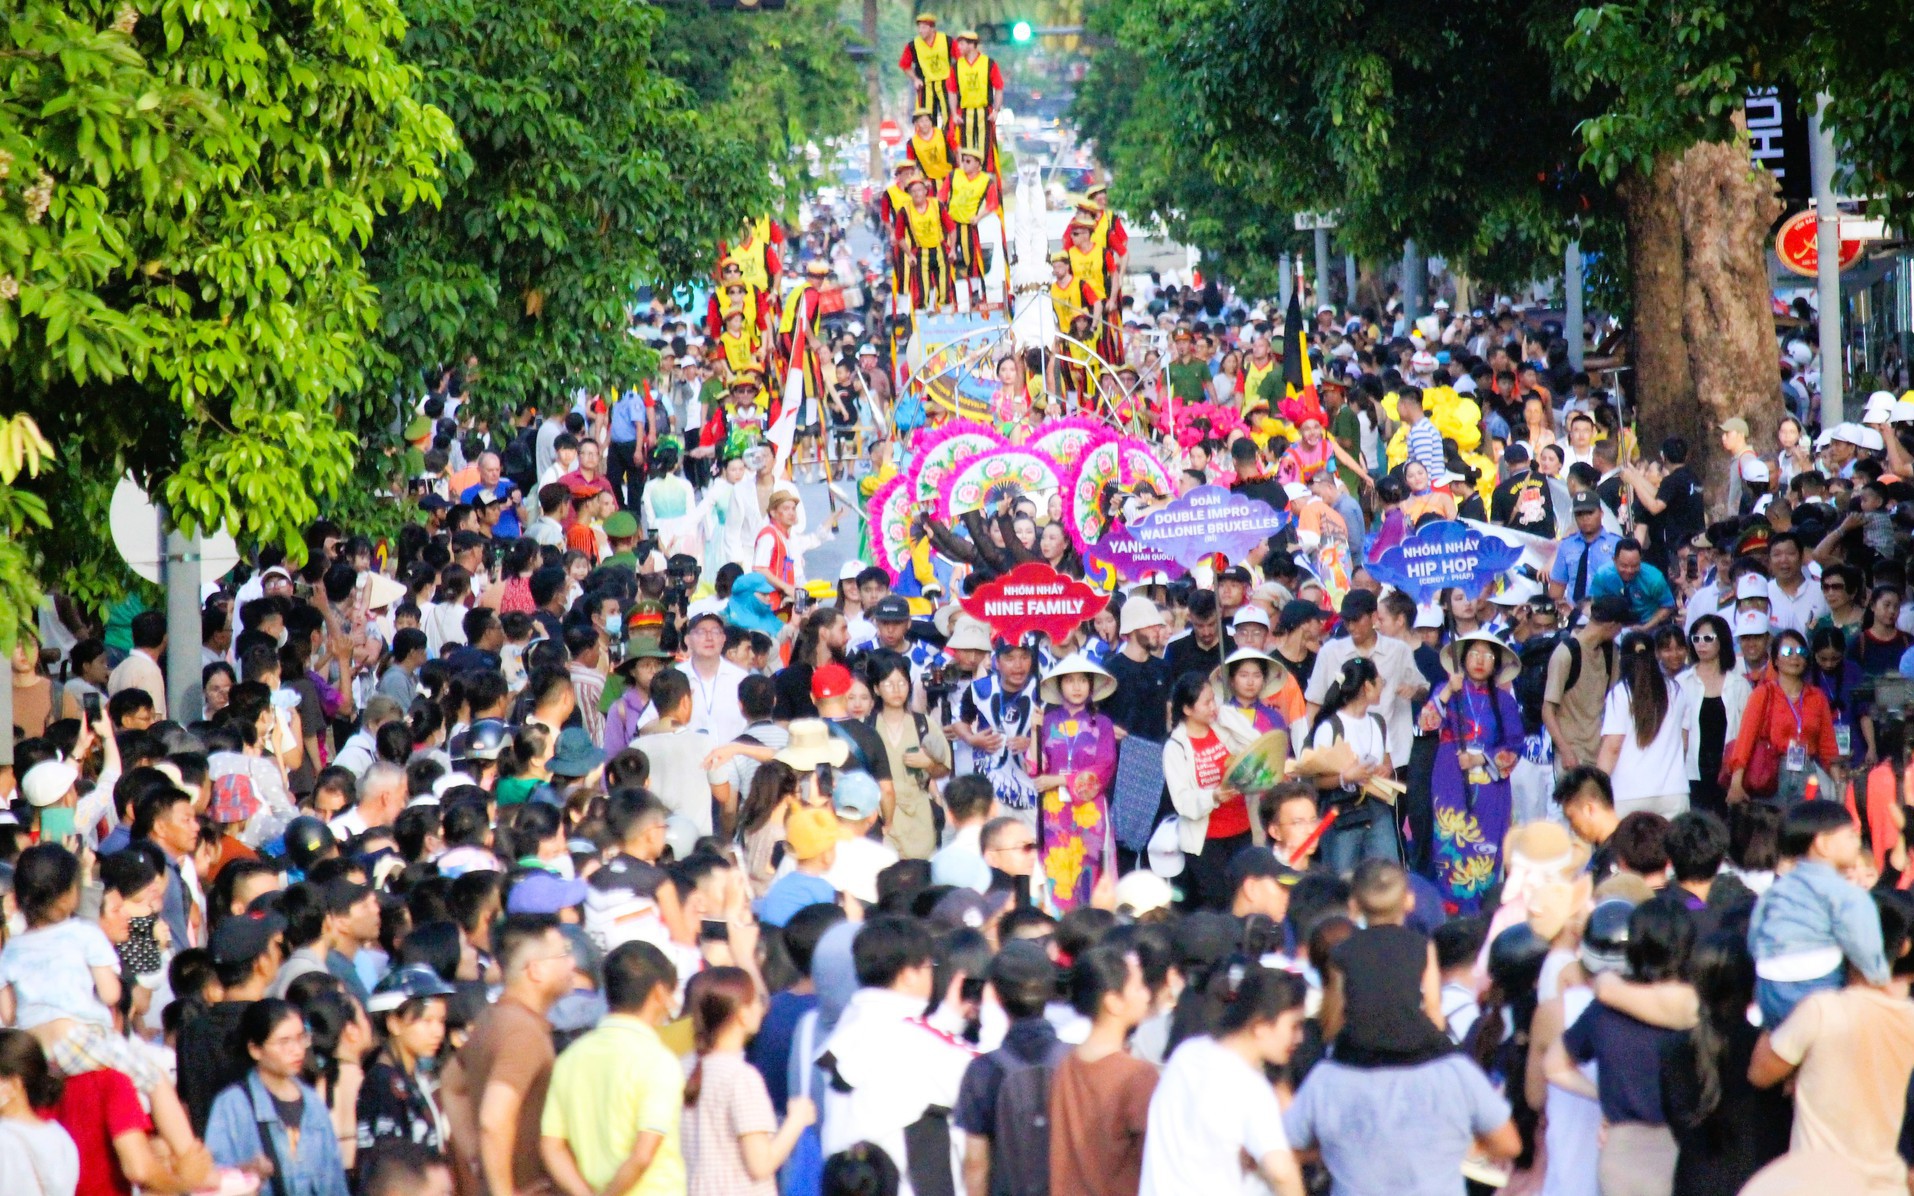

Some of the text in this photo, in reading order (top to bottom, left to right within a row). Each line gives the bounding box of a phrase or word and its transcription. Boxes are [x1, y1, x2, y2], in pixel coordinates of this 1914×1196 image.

[1190, 495, 1221, 507] ĐOÀN
[1154, 509, 1205, 525] DOUBLE
[1207, 506, 1249, 520] IMPRO
[1140, 518, 1279, 541] WALLONIE BRUXELLES
[1403, 543, 1442, 558] NHÓM
[1407, 557, 1479, 578] HIP HOP
[1419, 575, 1445, 586] (CERGY
[1451, 572, 1474, 582] PHÁP)
[1004, 584, 1034, 596] NHÓM
[984, 600, 1084, 616] NINE FAMILY
